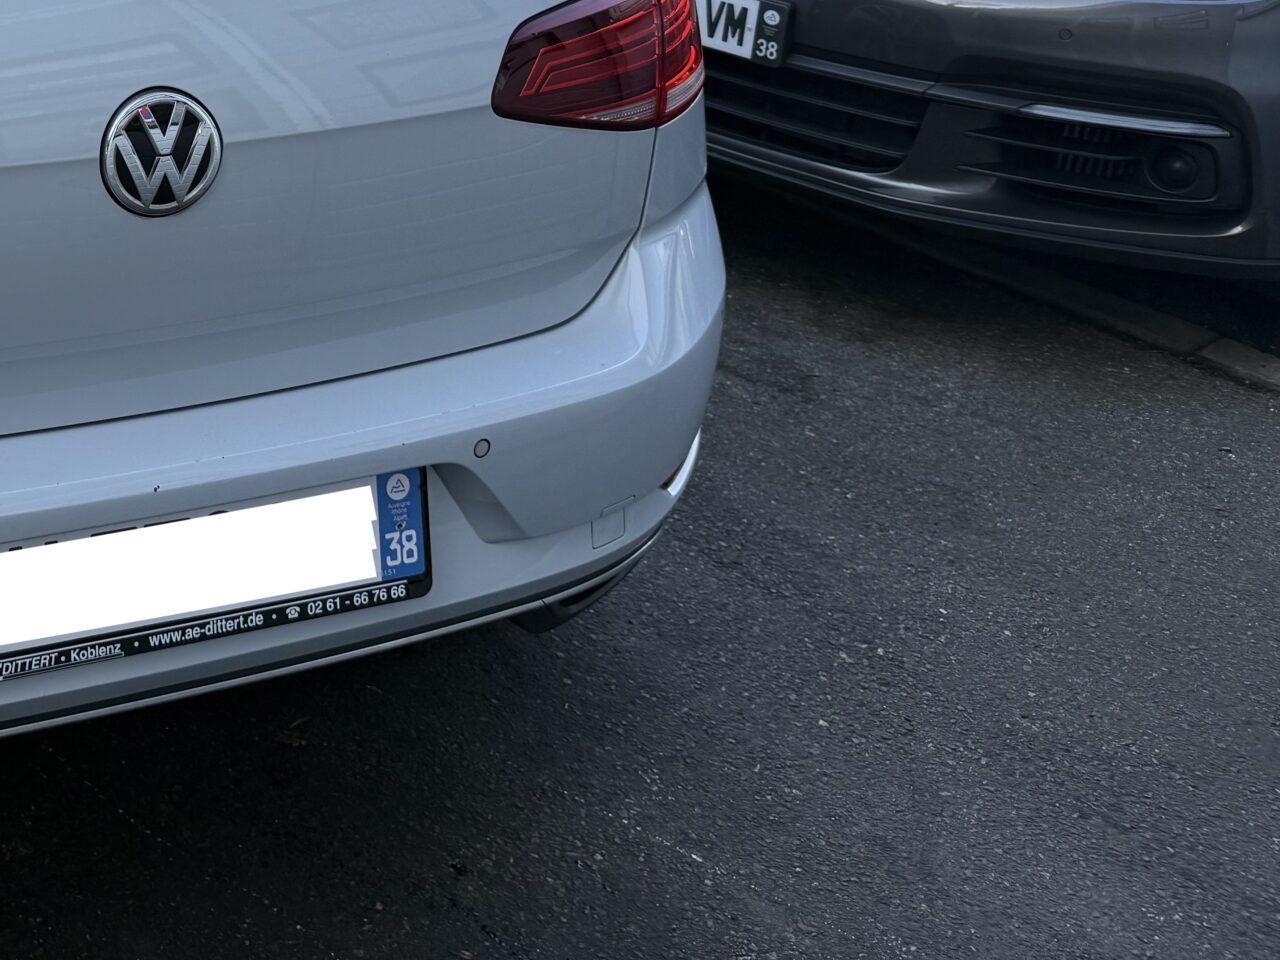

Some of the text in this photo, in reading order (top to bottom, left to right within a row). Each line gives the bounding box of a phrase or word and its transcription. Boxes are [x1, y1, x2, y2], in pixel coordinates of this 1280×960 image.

[756, 38, 778, 60] 38
[384, 529, 419, 567] 38
[70, 643, 122, 663] Koblenz
[148, 611, 264, 647] www.ae-dittert.de
[307, 601, 323, 616] 02
[326, 597, 341, 612] 61
[353, 592, 369, 607] 66
[372, 589, 387, 603] 76
[390, 584, 406, 599] 66
